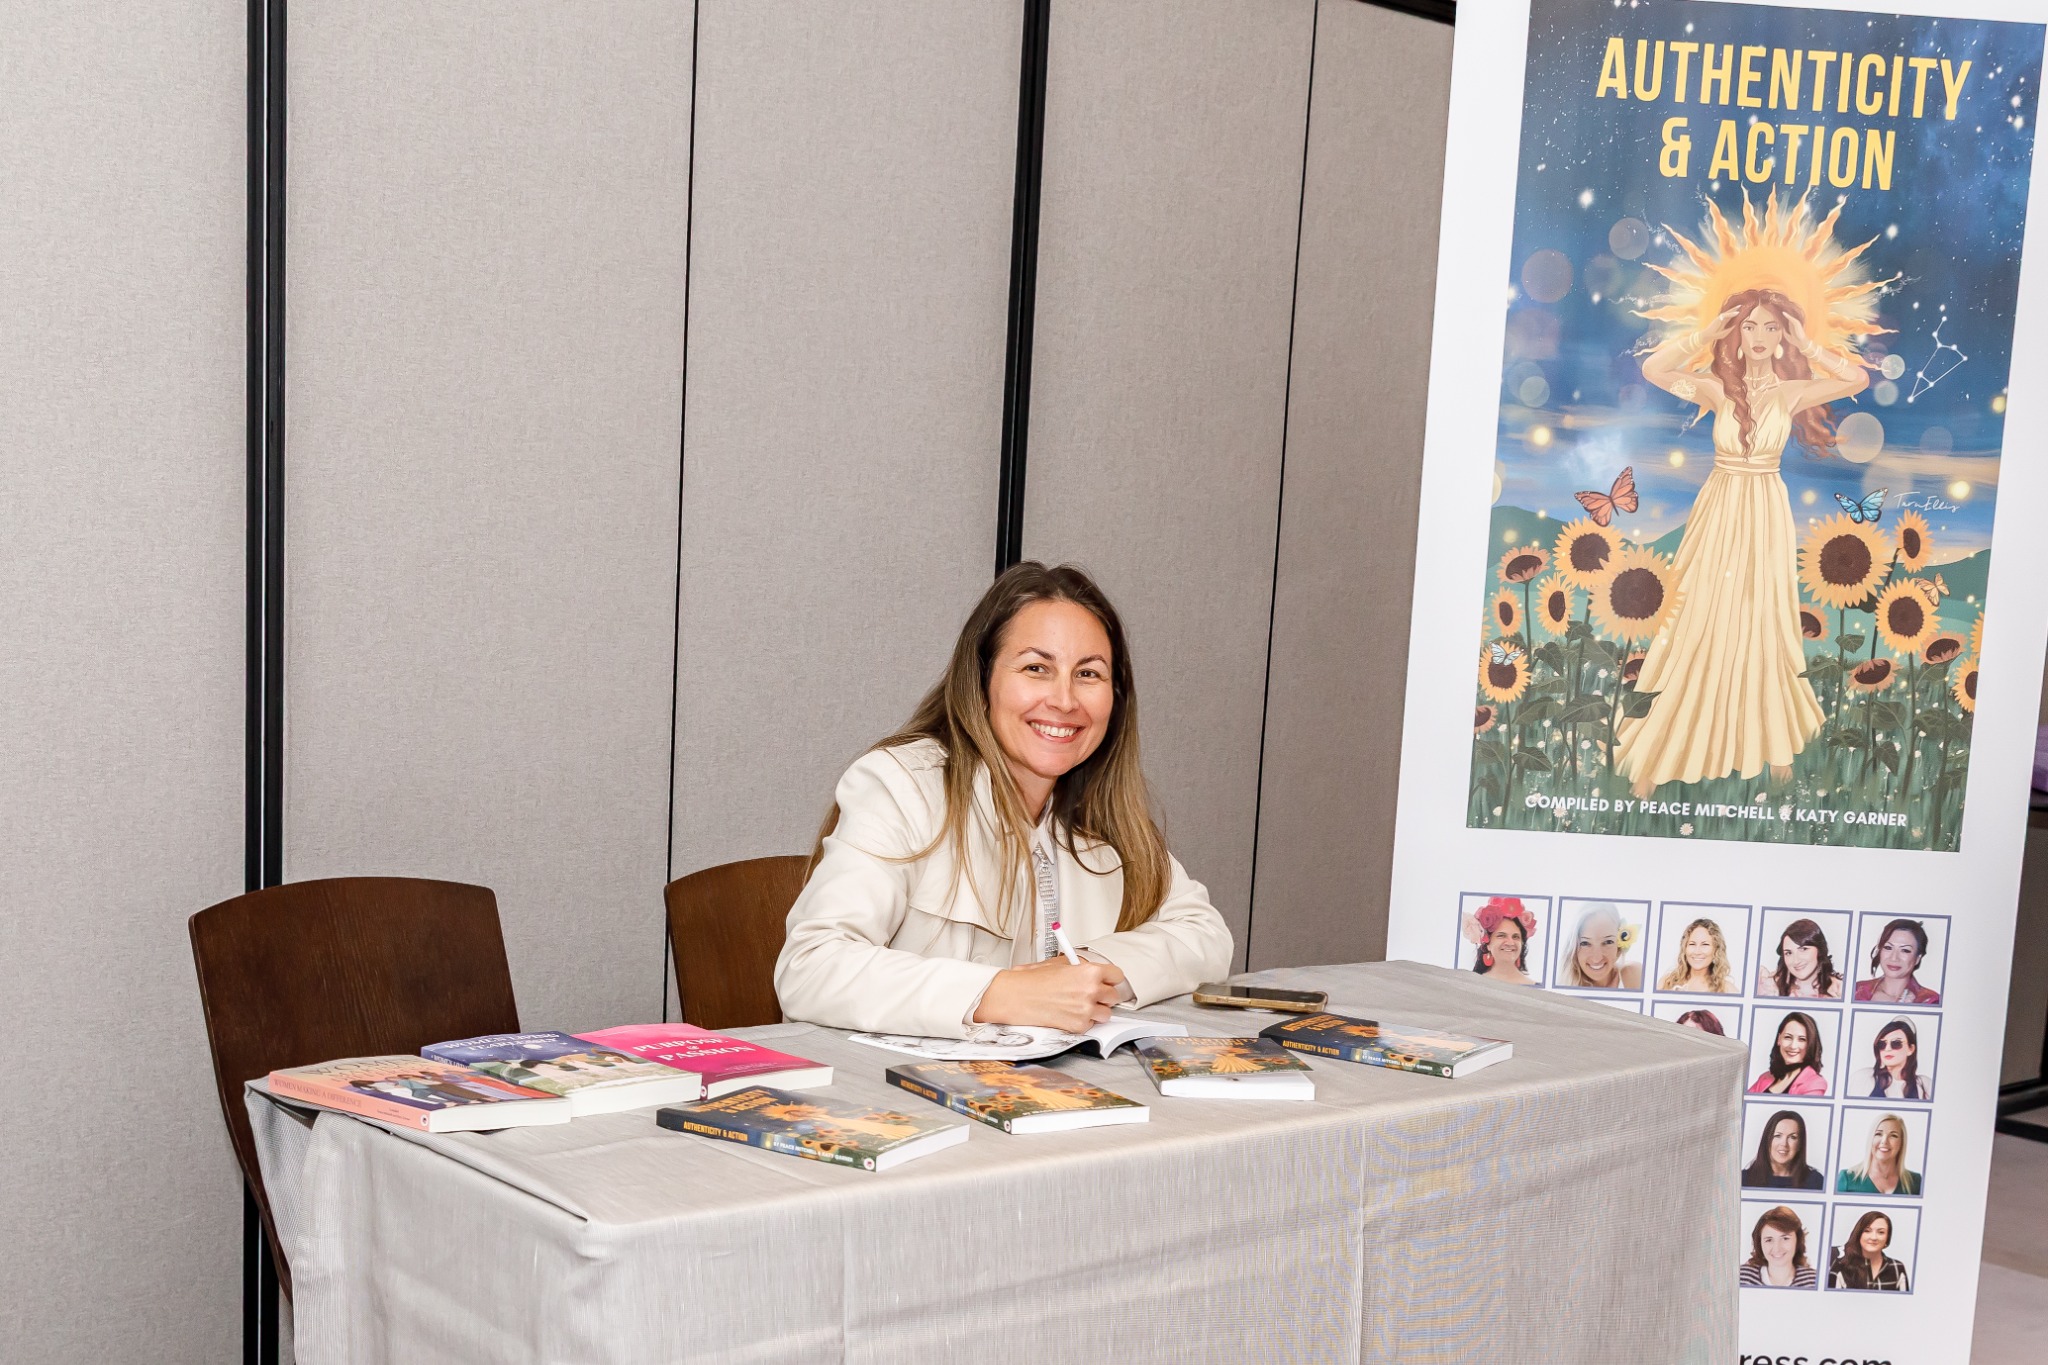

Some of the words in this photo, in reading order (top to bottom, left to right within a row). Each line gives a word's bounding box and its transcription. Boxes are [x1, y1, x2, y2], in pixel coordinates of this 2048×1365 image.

[1595, 37, 1973, 121] AUTHENTICITY
[1659, 116, 1692, 178] &
[1707, 119, 1897, 191] ACTION
[1525, 794, 1609, 813] COMPILED
[1613, 799, 1634, 813] BY
[1639, 801, 1691, 816] PEACE
[1694, 803, 1775, 820] MITCHELL
[1778, 806, 1792, 822] &
[1796, 808, 1839, 823] KATY
[1843, 810, 1908, 828] GARNER
[633, 1037, 728, 1052] PURPOSE
[656, 1046, 757, 1061] PASSION
[1281, 1040, 1317, 1052] AUTHENTICITY
[1322, 1046, 1340, 1056] ACTION
[683, 1120, 722, 1137] AUTHENTICITY
[728, 1130, 748, 1142] ACTION
